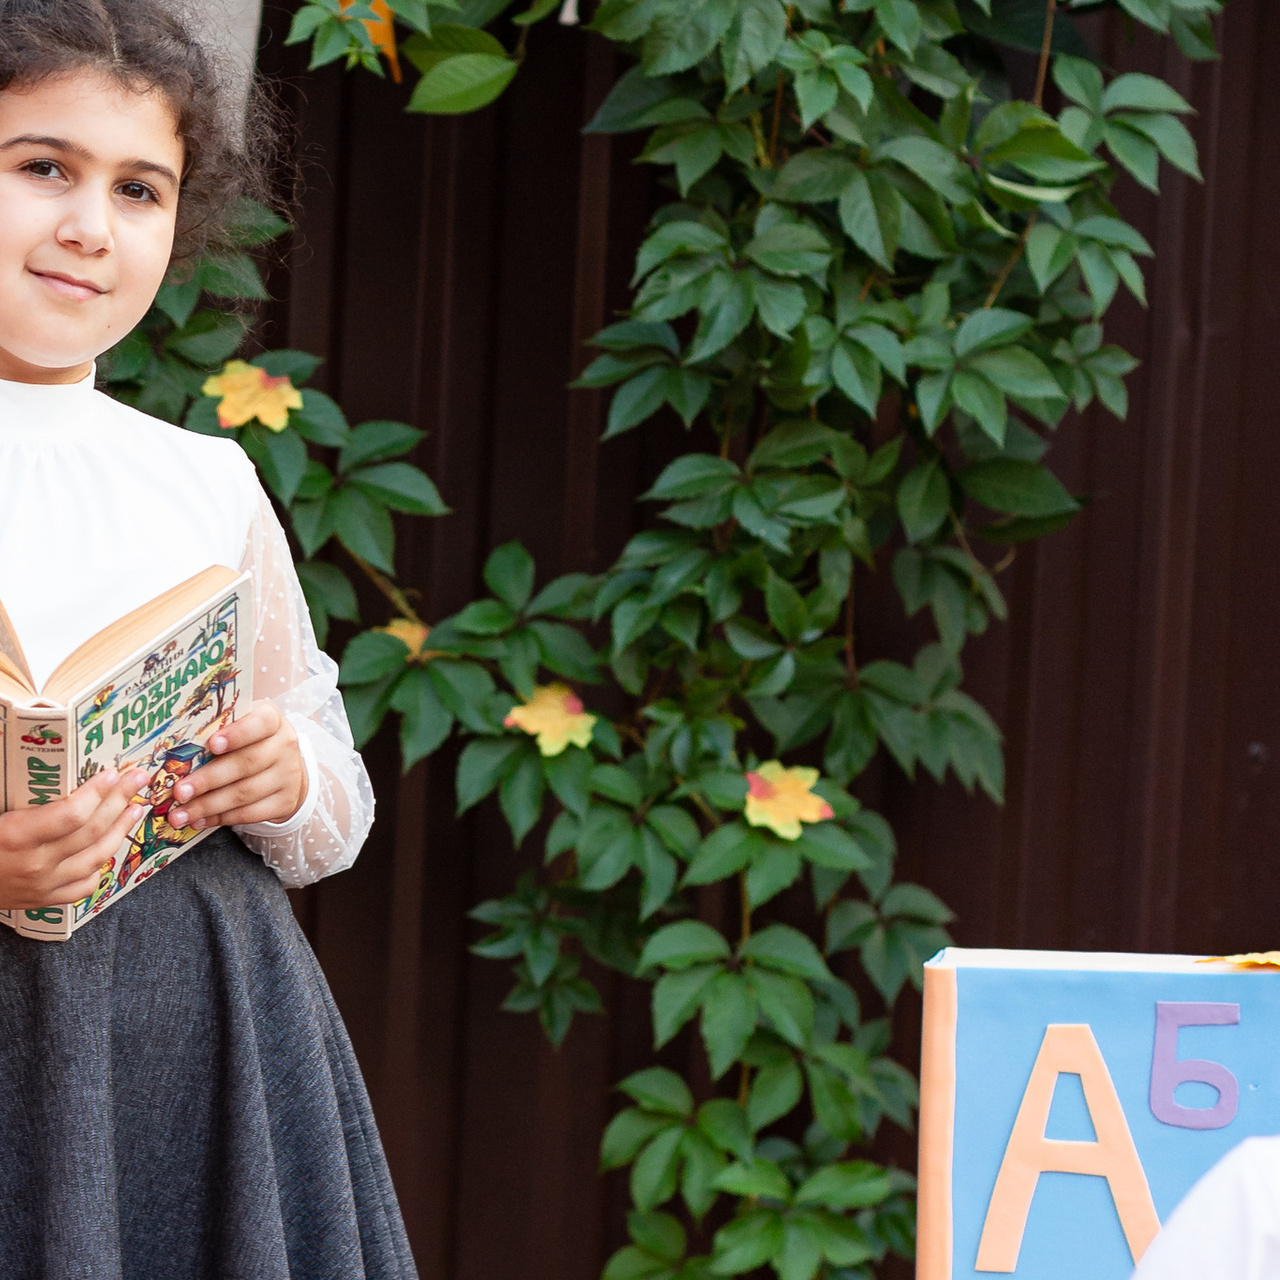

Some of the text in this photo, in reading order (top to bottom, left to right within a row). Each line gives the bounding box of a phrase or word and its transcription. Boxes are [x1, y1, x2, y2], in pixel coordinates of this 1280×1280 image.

[84, 639, 225, 756] Я ПОЗНАЮ
[122, 692, 182, 750] МИР
[975, 1001, 1241, 1273] А Б
